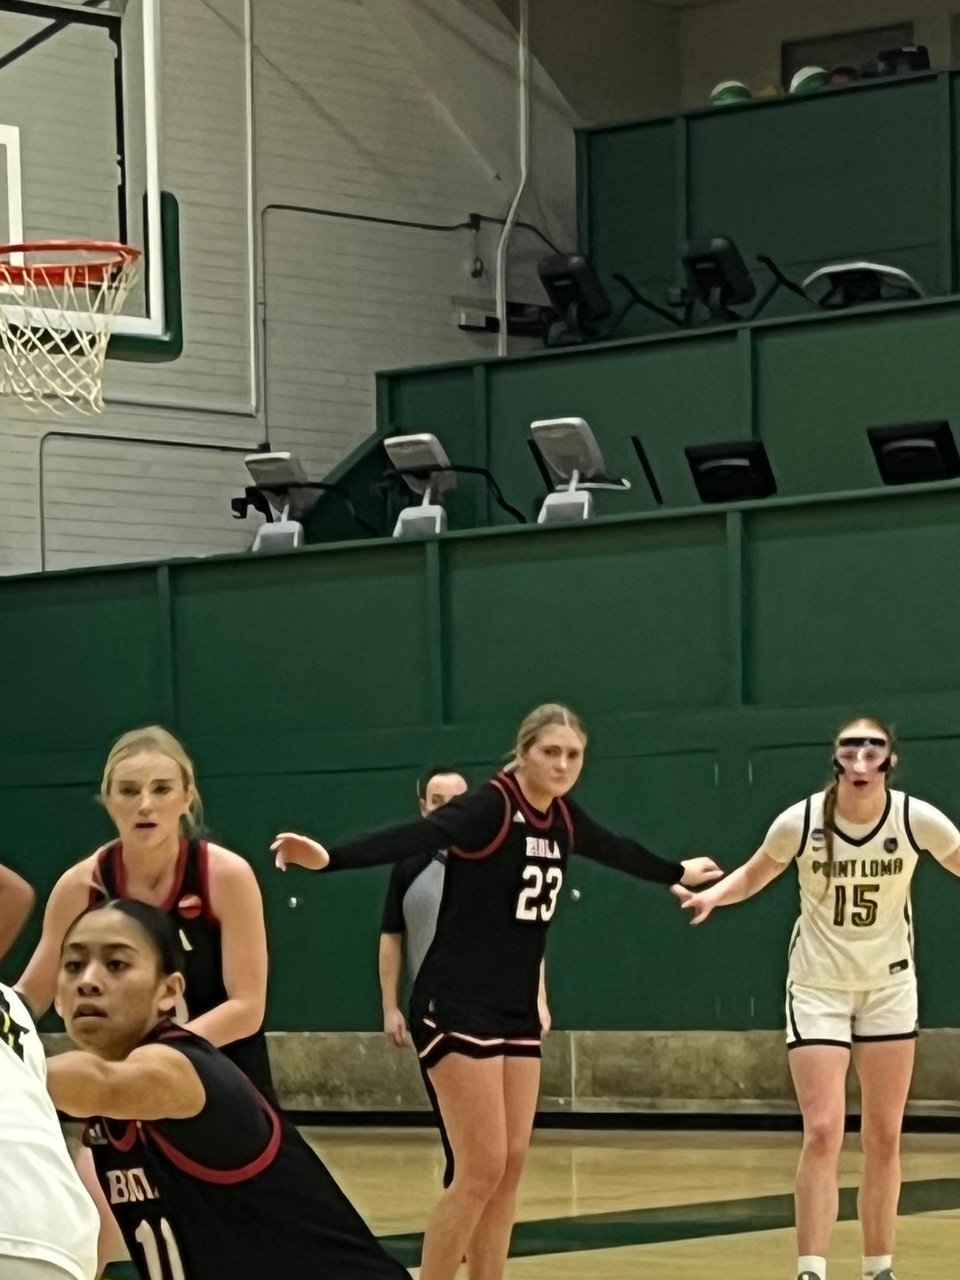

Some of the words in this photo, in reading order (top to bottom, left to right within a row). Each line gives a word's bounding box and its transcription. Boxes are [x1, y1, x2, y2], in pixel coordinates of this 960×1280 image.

[860, 857, 904, 878] LOMA
[515, 865, 563, 922] 23
[833, 883, 881, 927] 15
